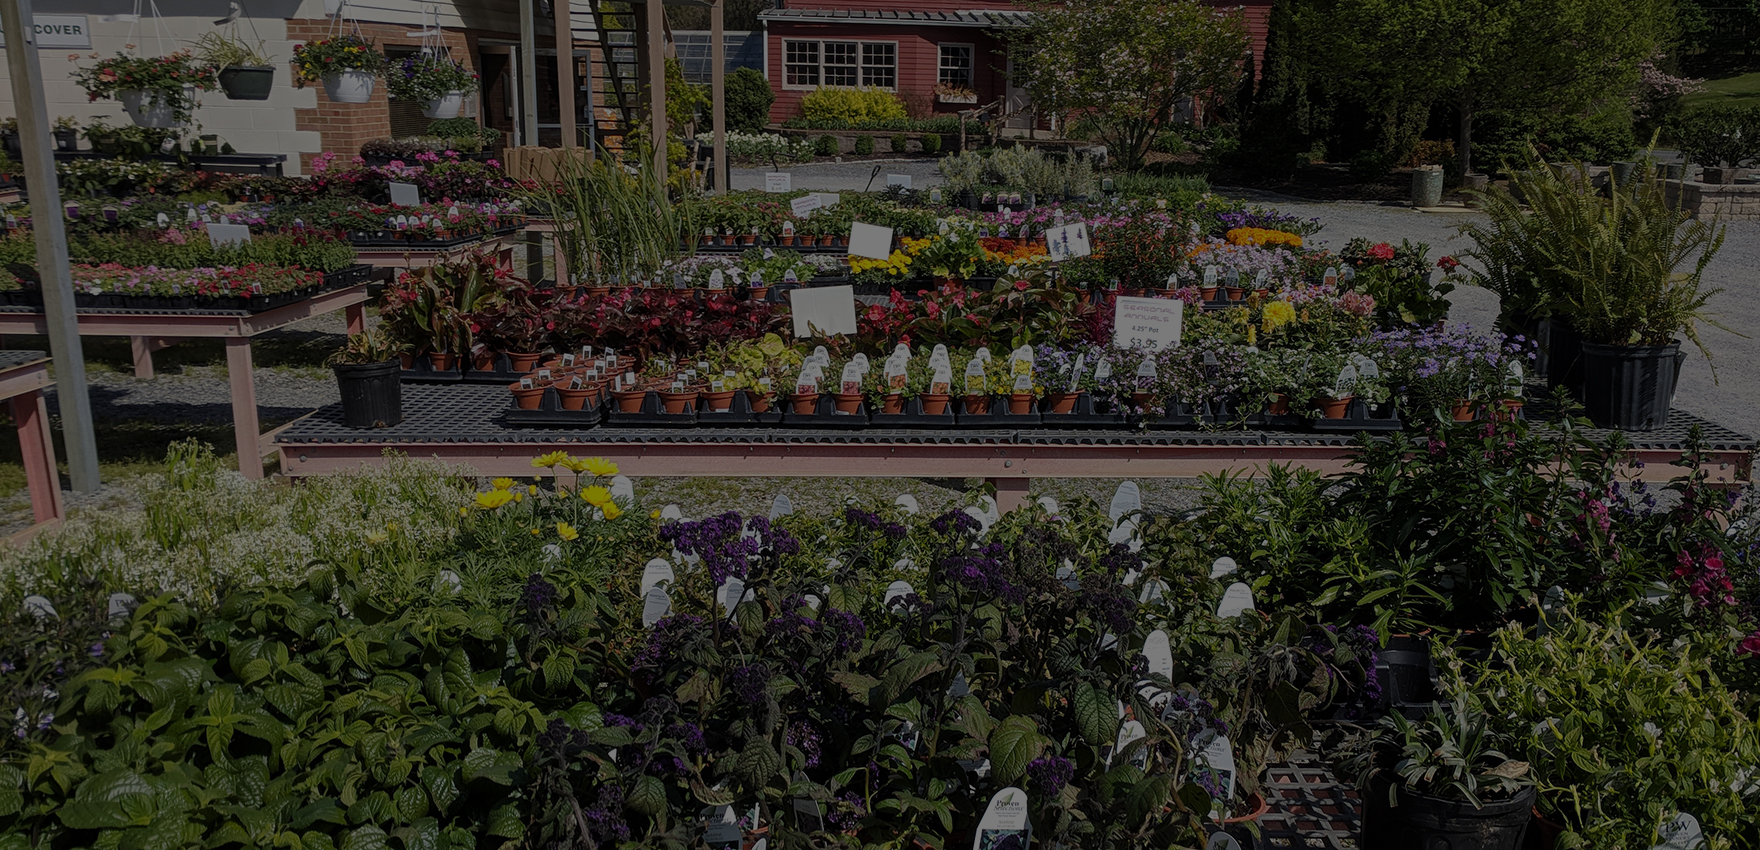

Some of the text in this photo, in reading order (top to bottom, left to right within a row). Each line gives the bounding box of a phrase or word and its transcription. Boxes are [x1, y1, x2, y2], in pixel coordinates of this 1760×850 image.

[33, 24, 82, 35] COVER
[1123, 305, 1175, 314] SEASONAL
[1124, 313, 1169, 322] ANNUALS
[1130, 337, 1157, 348] $3.95
[1665, 820, 1692, 833] PW
